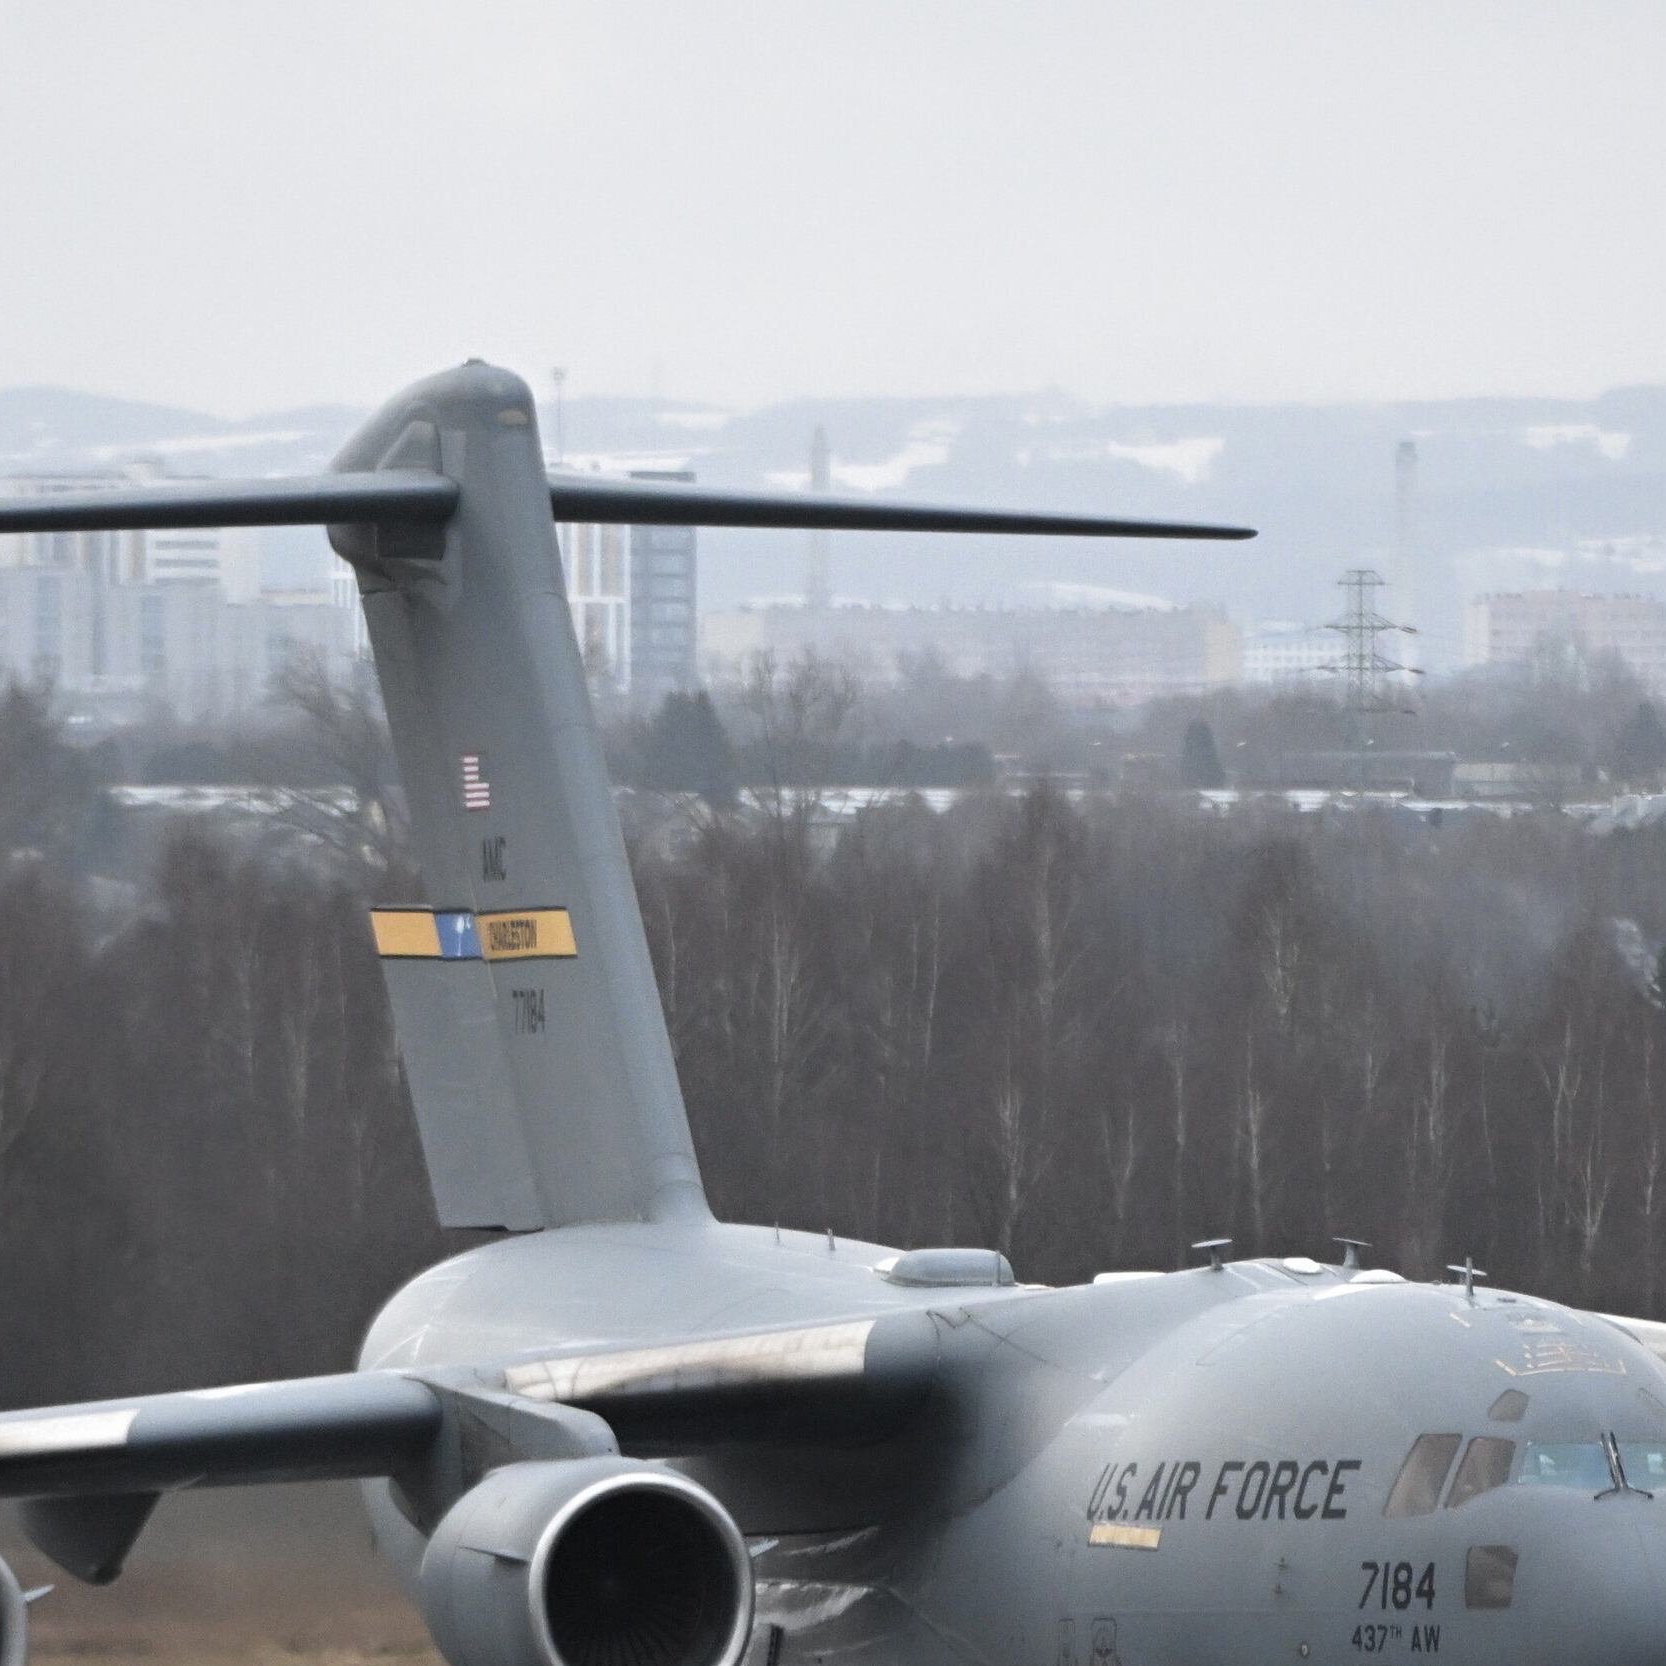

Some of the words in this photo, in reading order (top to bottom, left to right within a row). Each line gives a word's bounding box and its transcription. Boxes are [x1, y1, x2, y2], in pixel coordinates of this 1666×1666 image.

[1086, 1462, 1138, 1521] U.S.
[1134, 1461, 1202, 1521] AIR
[1205, 1459, 1363, 1521] FORCE
[1358, 1561, 1437, 1610] 7184
[1411, 1625, 1441, 1652] AW
